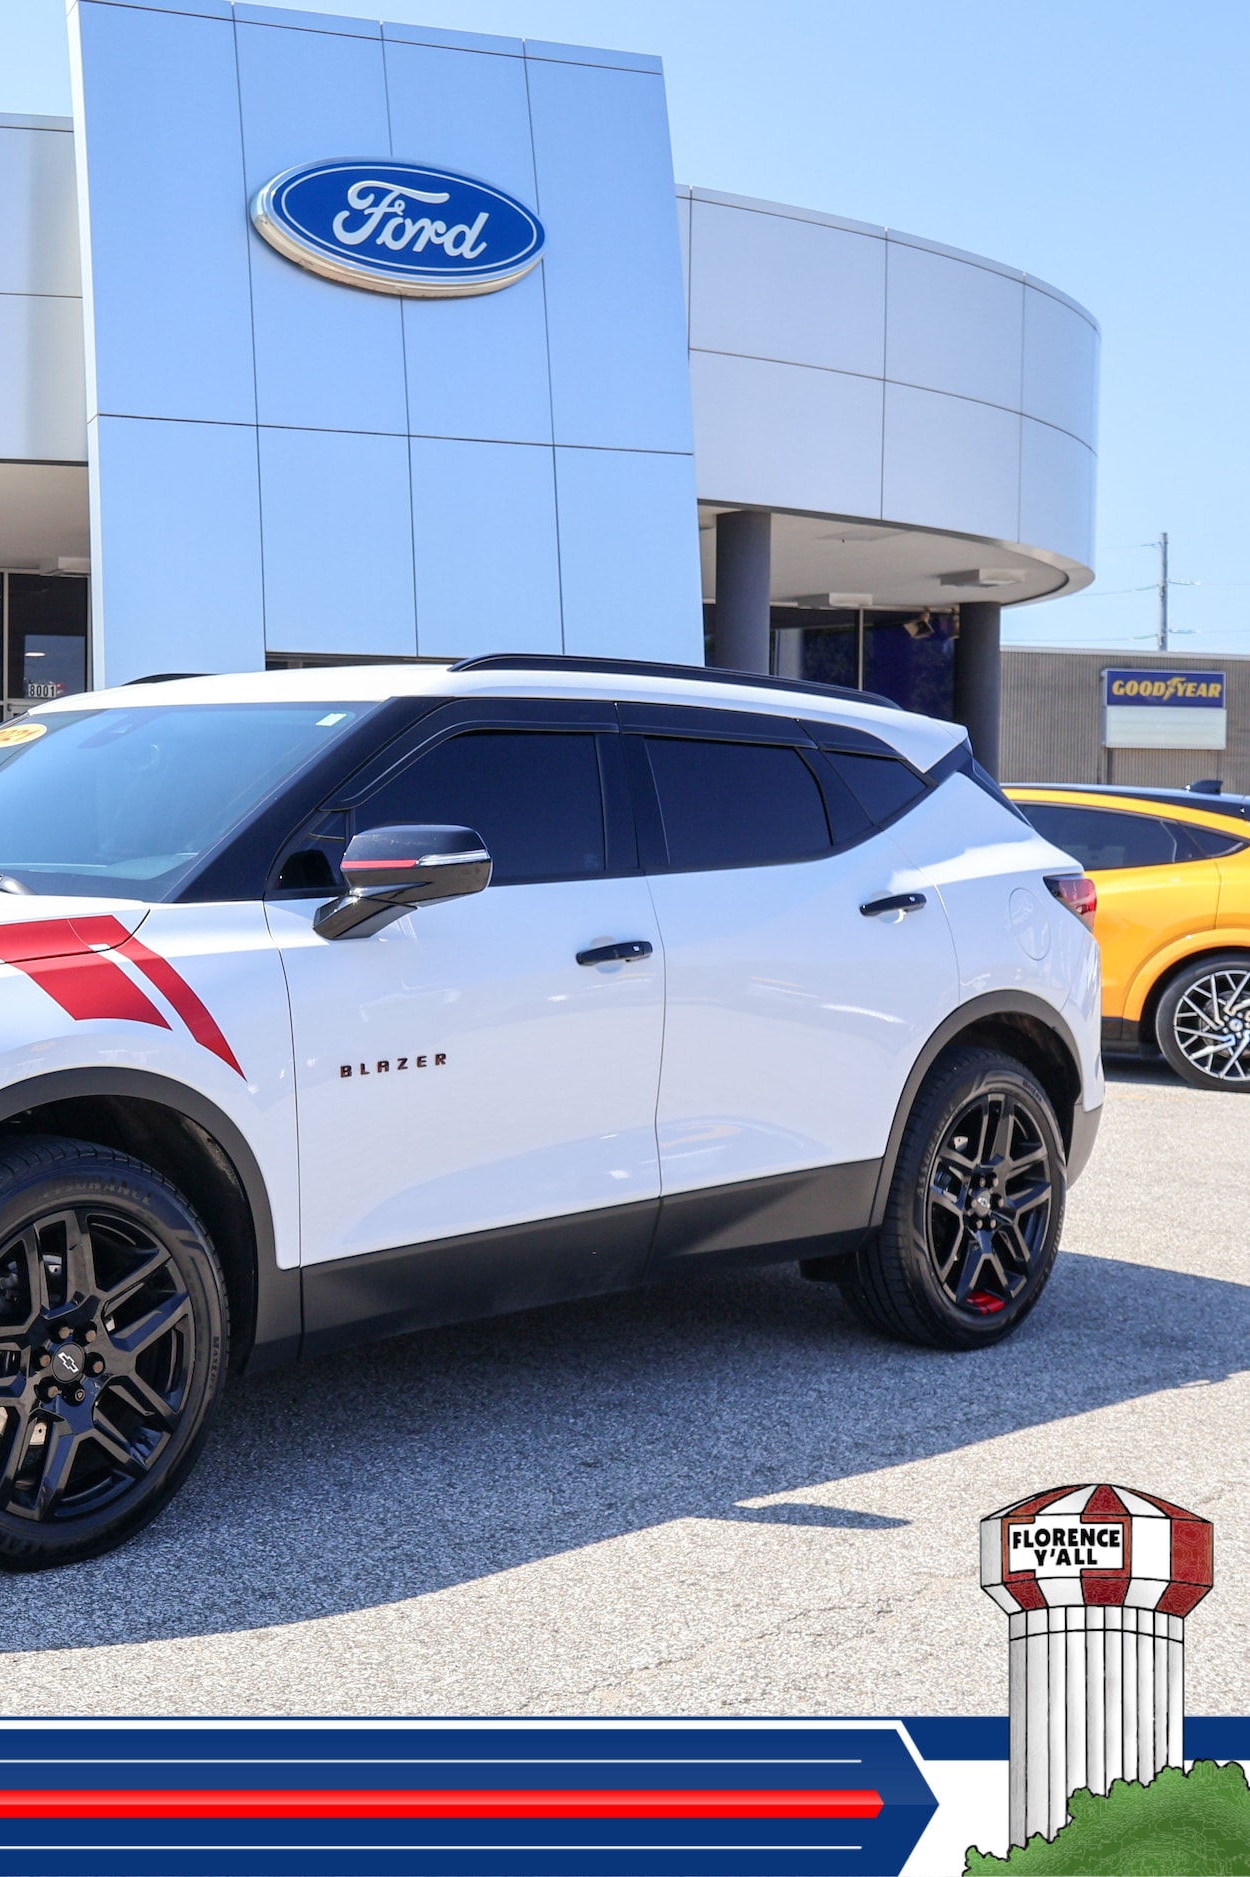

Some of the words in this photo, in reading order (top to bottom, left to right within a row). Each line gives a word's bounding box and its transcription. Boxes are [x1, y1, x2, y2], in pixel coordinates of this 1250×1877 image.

[332, 179, 489, 259] Ford
[29, 684, 56, 697] 8001
[1112, 677, 1222, 700] GOODYEAR
[340, 1053, 447, 1078] BLAZER
